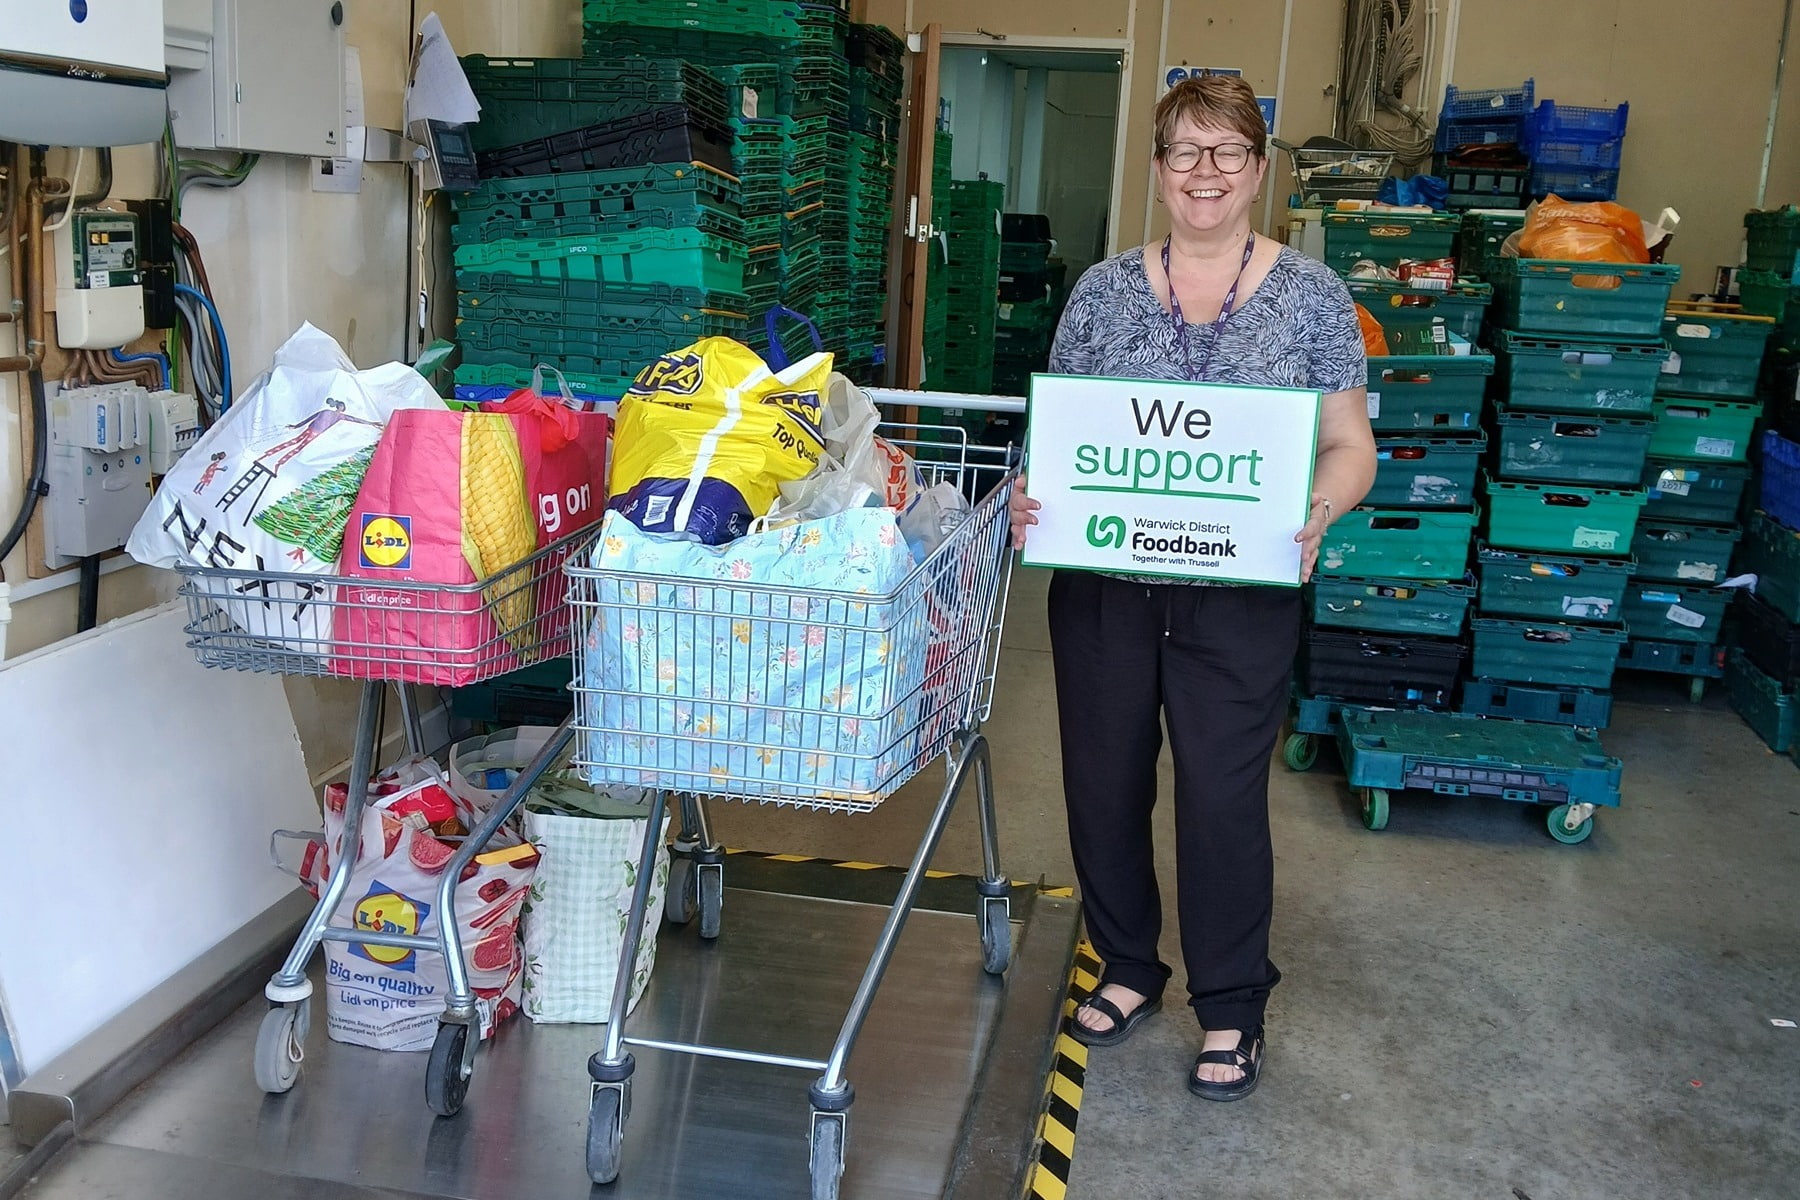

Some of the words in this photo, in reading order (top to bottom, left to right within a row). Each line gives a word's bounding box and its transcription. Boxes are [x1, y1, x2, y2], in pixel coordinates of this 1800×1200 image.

[1131, 397, 1212, 439] We
[772, 422, 795, 450] Top
[1074, 444, 1264, 491] support
[566, 483, 591, 515] on
[1134, 517, 1187, 531] Warwick
[1188, 521, 1231, 535] District
[1132, 532, 1237, 558] Foodbank
[1132, 554, 1167, 564] Together
[1168, 557, 1186, 566] with
[1188, 558, 1220, 568] Trussell
[329, 959, 350, 982] Big
[353, 973, 375, 984] on
[377, 976, 435, 996] quality
[340, 990, 361, 1006] Lidl
[363, 998, 378, 1009] on
[381, 999, 417, 1011] price
[399, 1024, 411, 1032] and
[411, 1019, 434, 1029] replace
